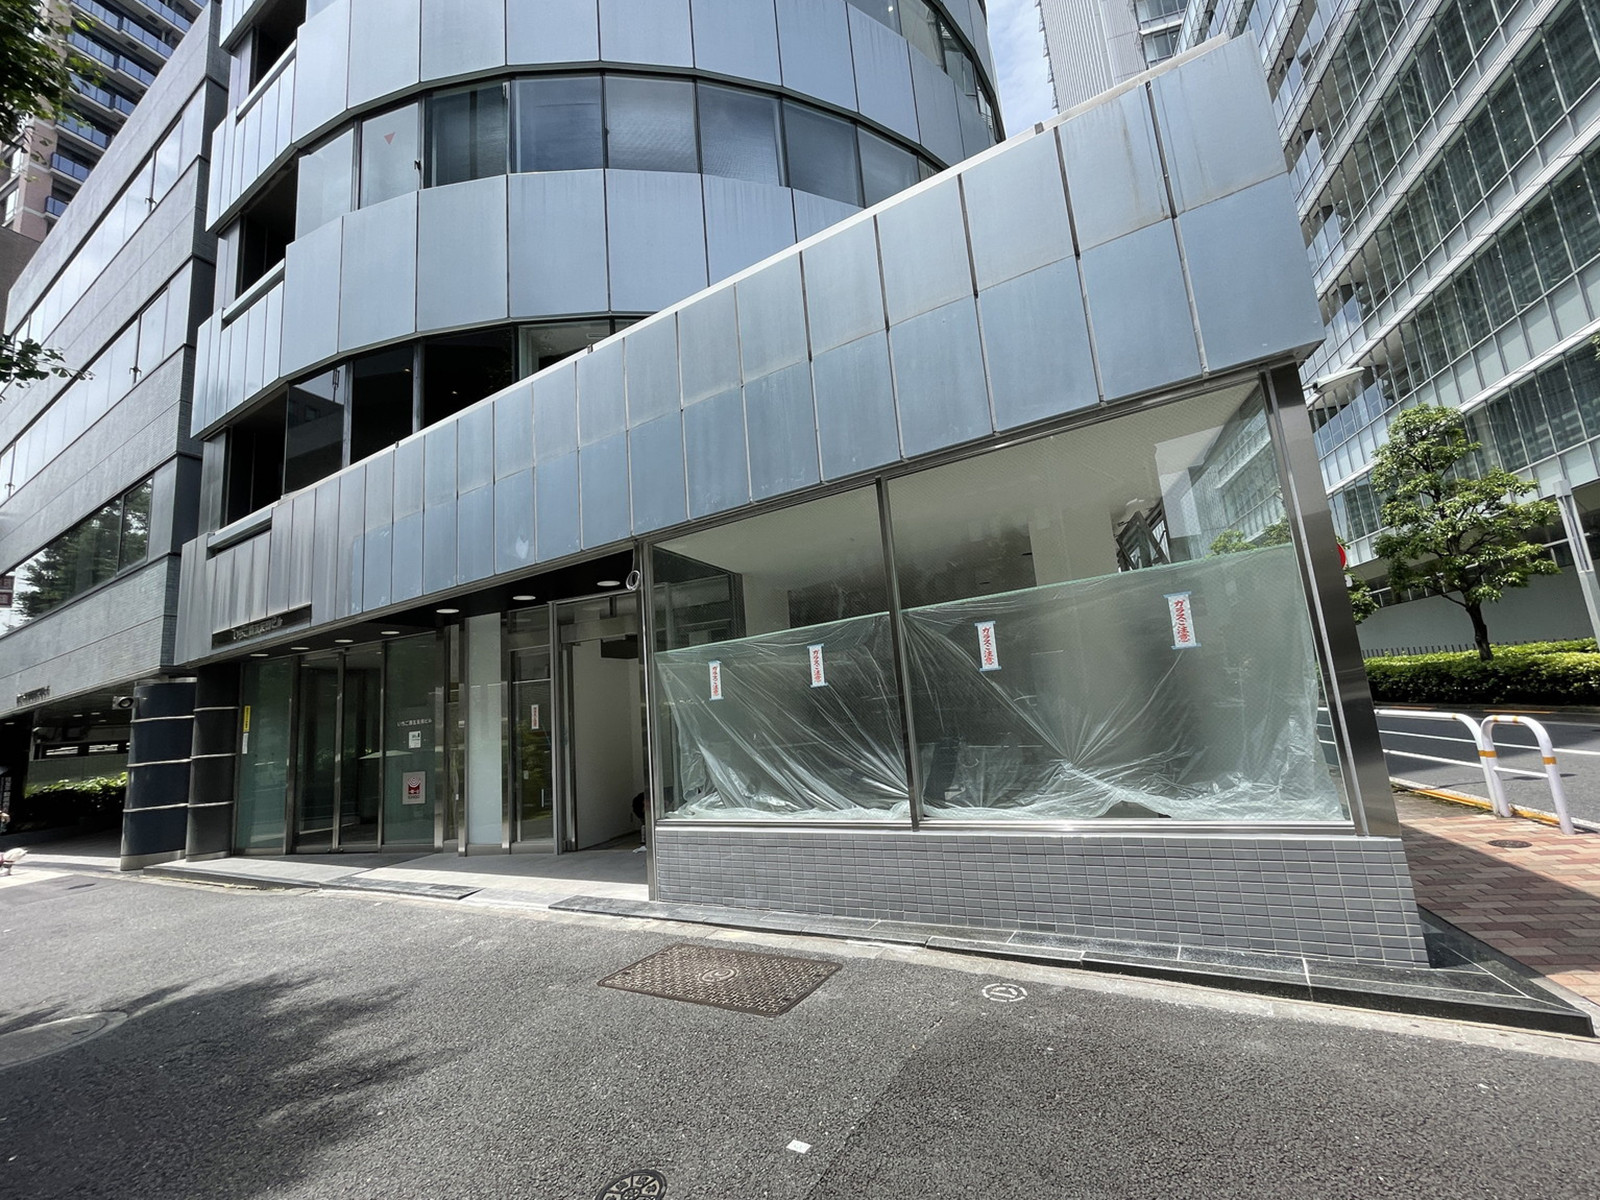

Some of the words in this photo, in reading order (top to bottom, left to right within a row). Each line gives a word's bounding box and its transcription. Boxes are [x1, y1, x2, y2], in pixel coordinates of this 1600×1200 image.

[1173, 599, 1191, 643] ガラスご注意
[981, 626, 995, 666] ガラスご注意
